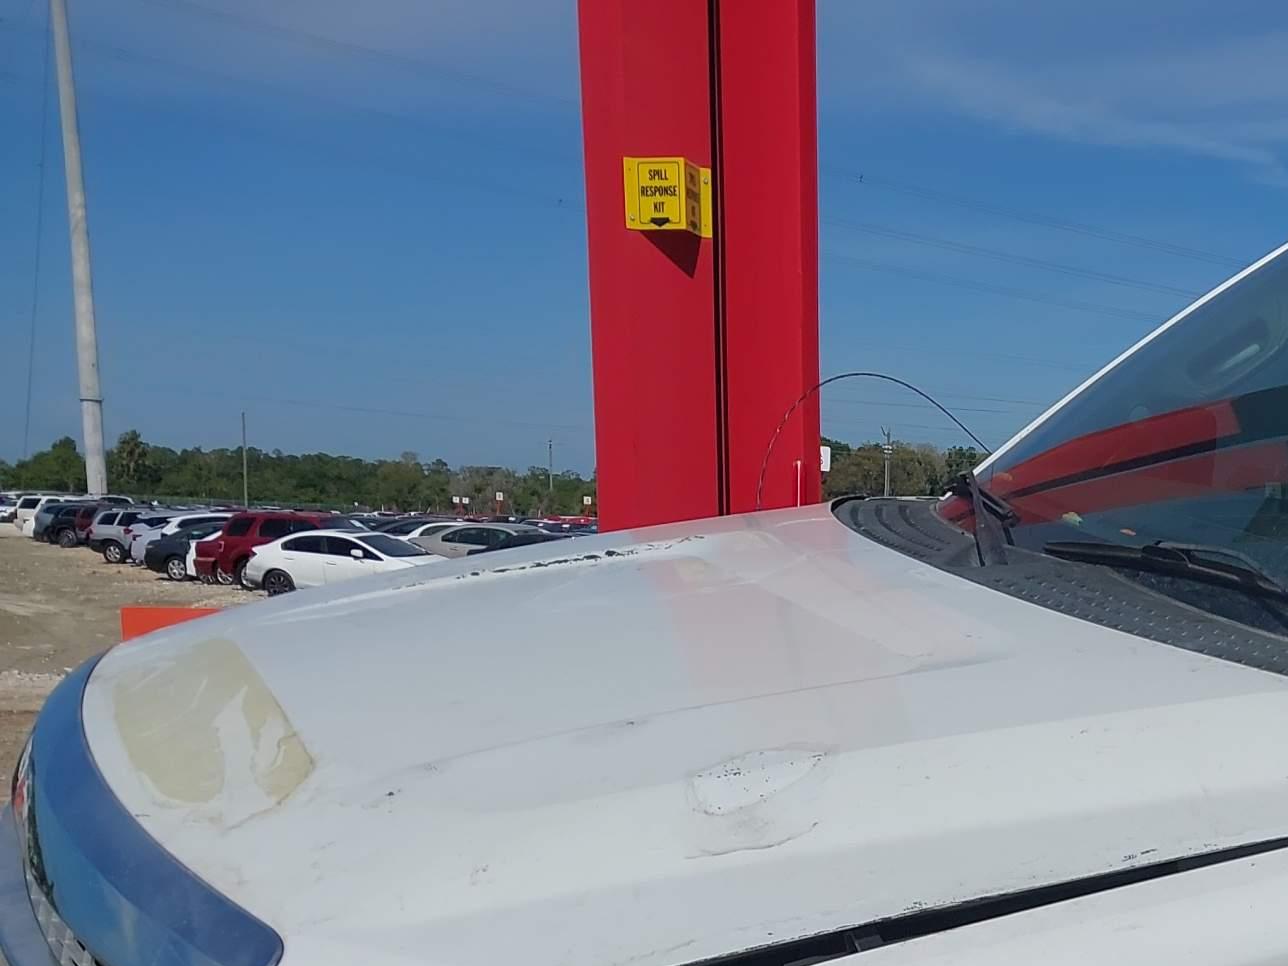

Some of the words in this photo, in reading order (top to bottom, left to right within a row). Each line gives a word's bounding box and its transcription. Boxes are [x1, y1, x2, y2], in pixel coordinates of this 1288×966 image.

[648, 169, 669, 181] SPILL
[640, 185, 678, 197] RESPONSE
[653, 202, 666, 213] KIT
